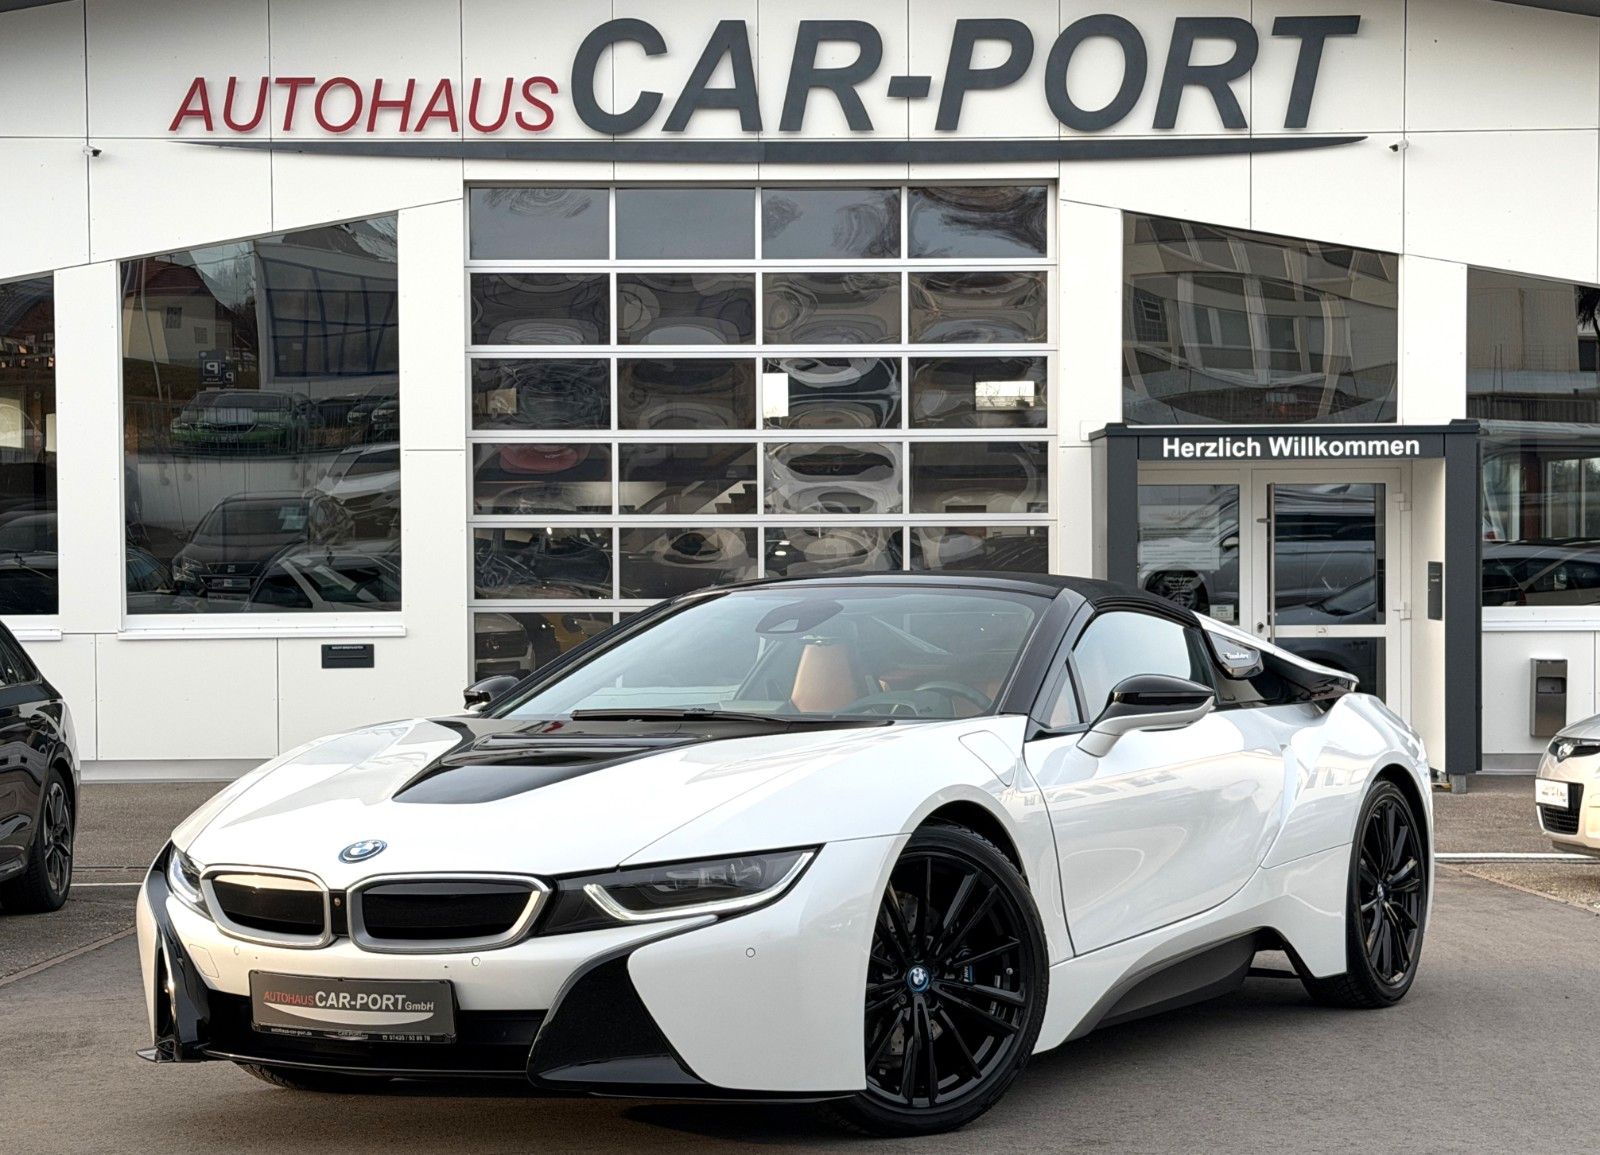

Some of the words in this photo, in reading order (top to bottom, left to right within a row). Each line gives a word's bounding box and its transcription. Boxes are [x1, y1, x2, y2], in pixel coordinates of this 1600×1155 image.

[170, 76, 559, 133] AUTOHAUS
[571, 14, 1361, 134] CAR-PORT
[1162, 437, 1262, 458] Herzlich
[1268, 436, 1421, 457] Willkommen
[263, 991, 315, 1006] AUTOHAUS
[315, 990, 407, 1011] CAR-PORT
[404, 1001, 434, 1011] GmbH
